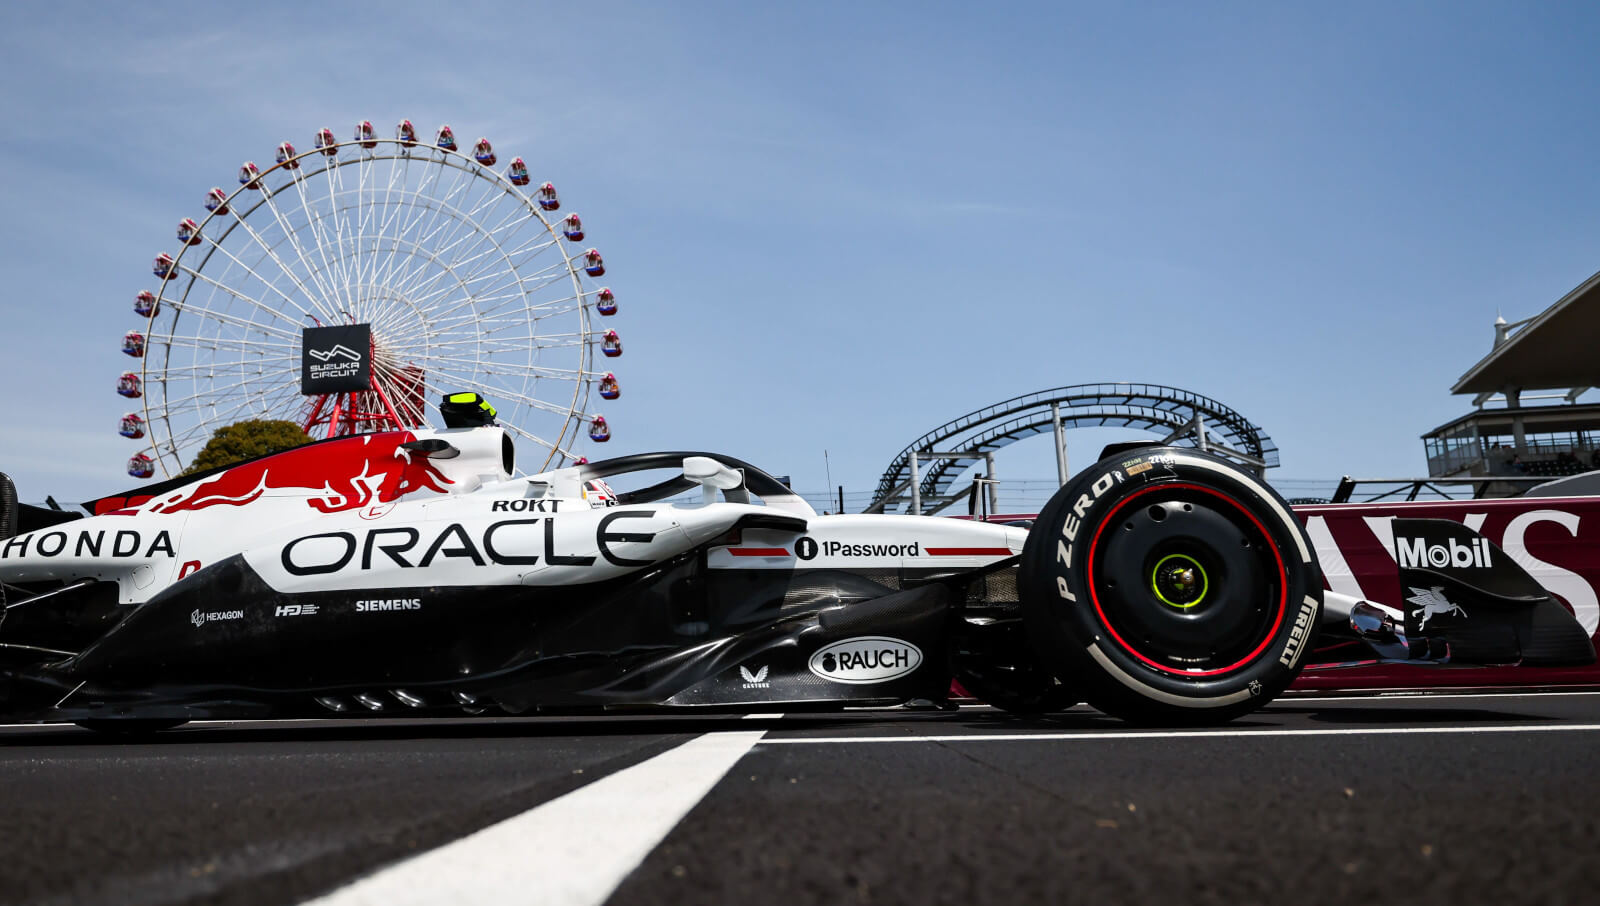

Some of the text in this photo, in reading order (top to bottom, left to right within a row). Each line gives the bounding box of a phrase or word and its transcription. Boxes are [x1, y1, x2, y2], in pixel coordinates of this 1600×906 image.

[310, 362, 360, 372] SUZUKA
[311, 370, 358, 379] CIRCUIT
[491, 499, 564, 513] ROKT
[2, 530, 175, 559] HONDA
[281, 510, 656, 576] ORACLE
[1056, 472, 1114, 602] P ZERO
[822, 541, 919, 557] 1Password
[1397, 537, 1492, 568] Mobil
[355, 598, 422, 612] SIEMENS
[206, 610, 244, 621] HEXAGON
[1280, 594, 1319, 670] PIRELLI
[839, 649, 908, 671] RAUCH
